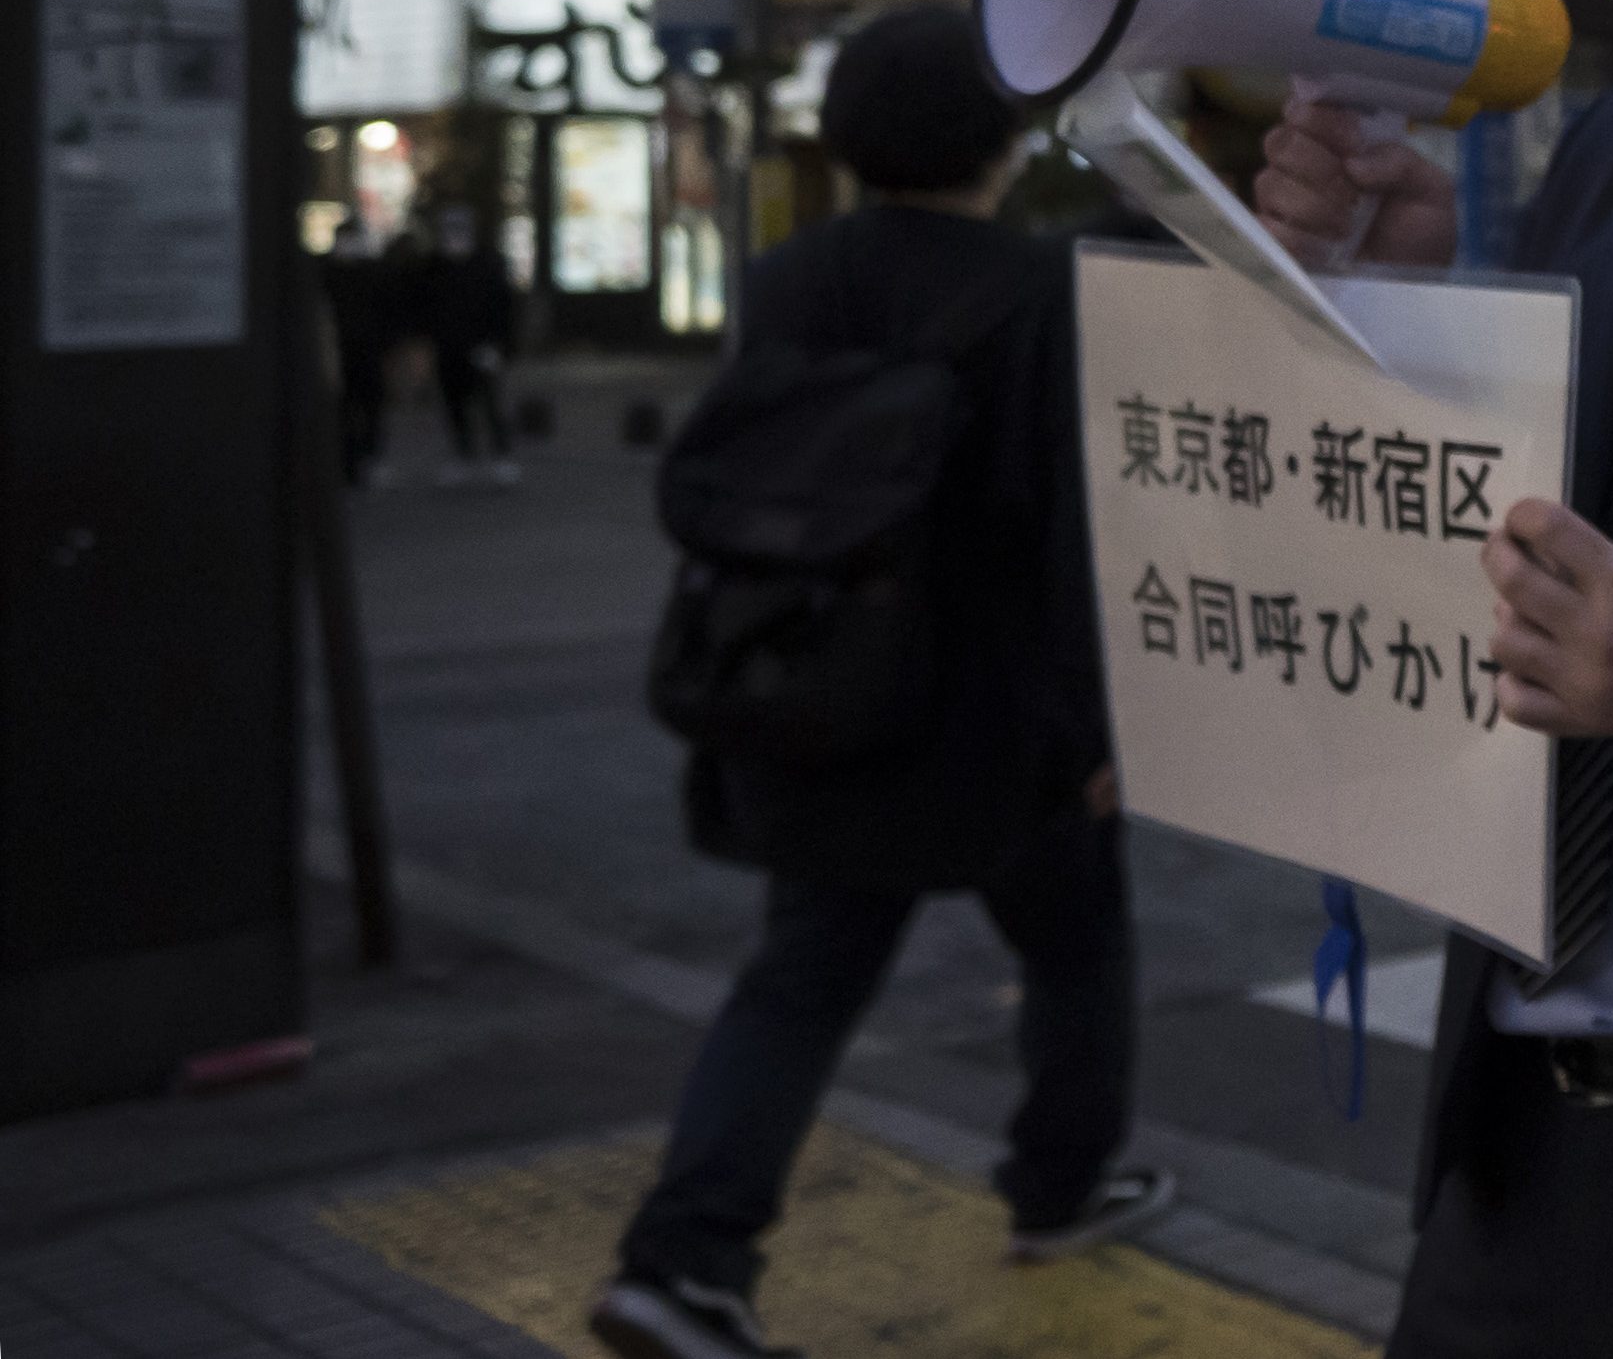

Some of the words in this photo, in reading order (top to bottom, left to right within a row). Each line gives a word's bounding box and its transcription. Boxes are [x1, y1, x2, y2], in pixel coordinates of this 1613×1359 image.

[1115, 393, 1503, 542] 東京都・新宿区
